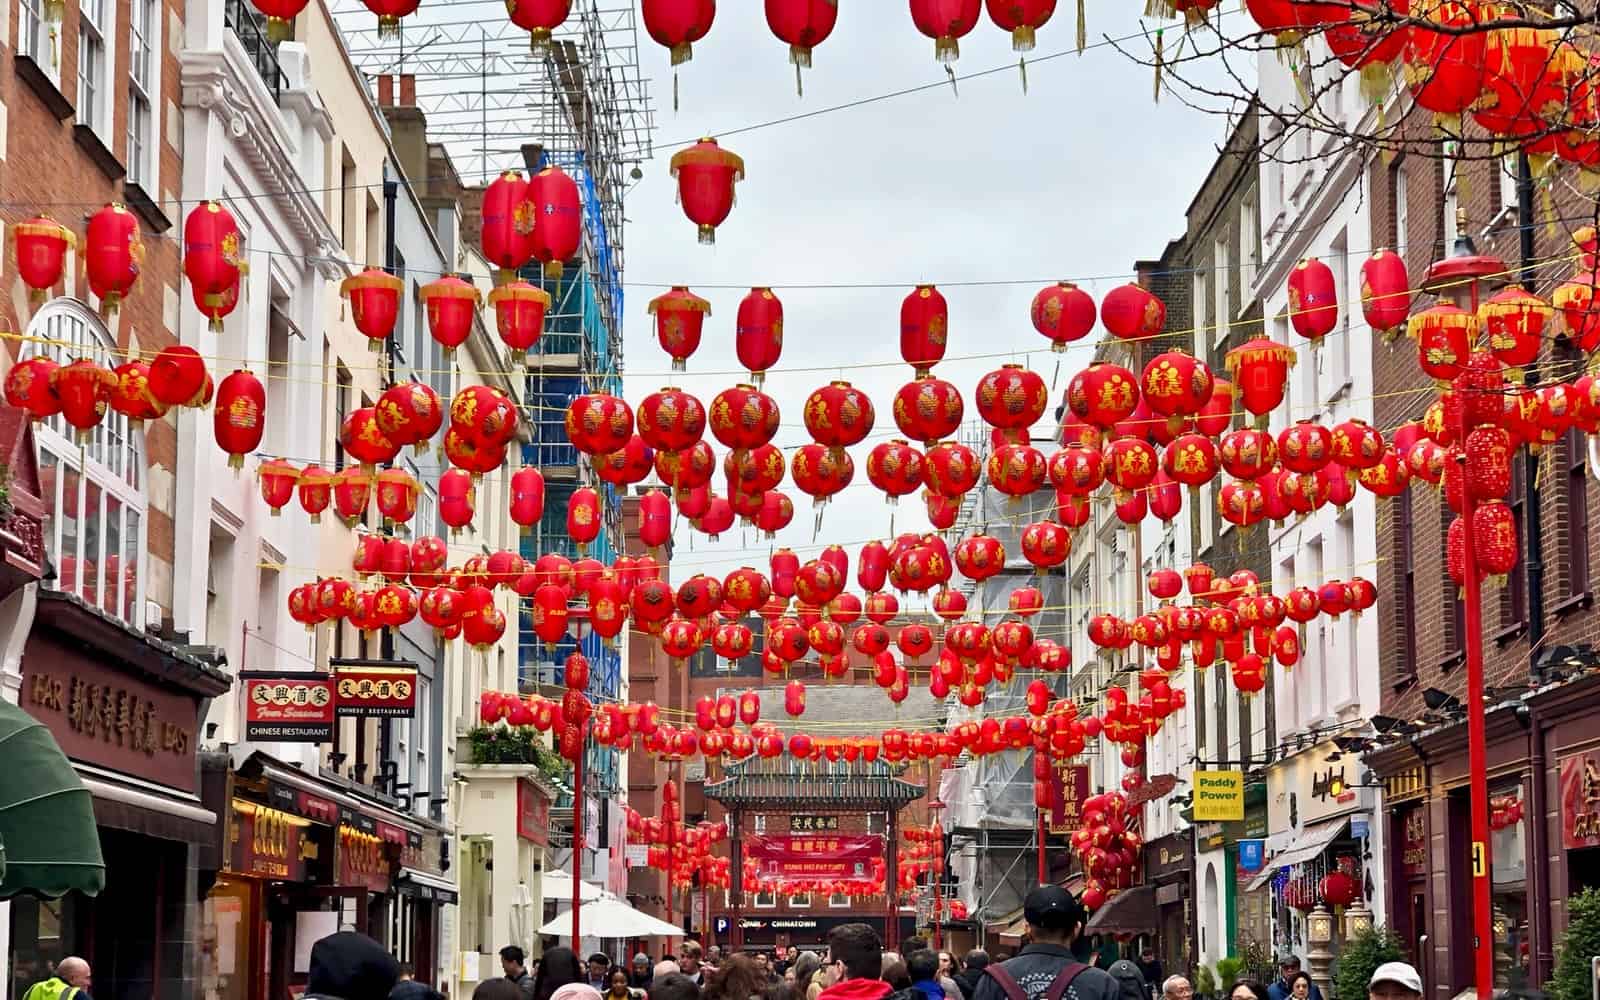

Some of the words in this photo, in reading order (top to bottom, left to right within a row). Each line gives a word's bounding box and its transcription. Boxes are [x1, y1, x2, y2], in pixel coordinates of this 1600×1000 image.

[31, 673, 63, 710] FAR
[255, 685, 328, 704] 文興酒家
[341, 680, 410, 697] 文興酒家
[256, 706, 281, 719] Four
[284, 707, 324, 719] Seasons
[161, 721, 191, 754] EAST
[250, 727, 281, 736] CHINESE
[282, 727, 329, 736] RESTAURANT
[1200, 777, 1236, 788] Paddy
[1200, 791, 1238, 800] Power
[718, 919, 727, 932] P
[771, 920, 817, 928] CHINATOWN
